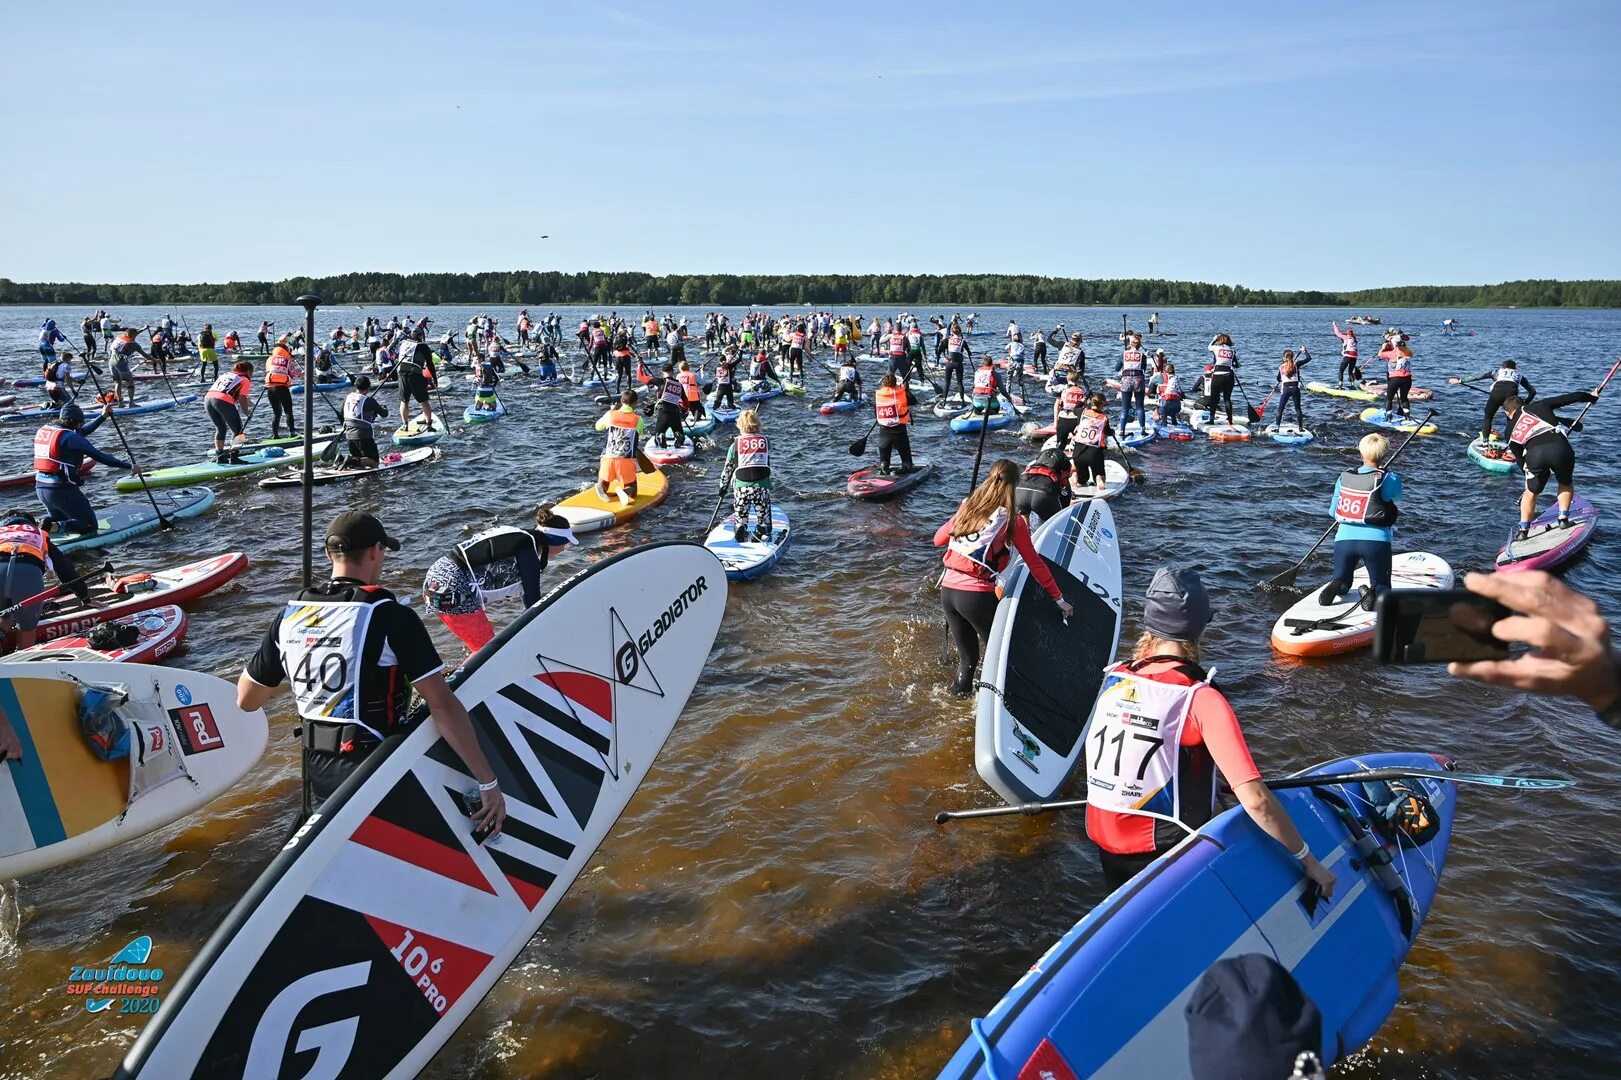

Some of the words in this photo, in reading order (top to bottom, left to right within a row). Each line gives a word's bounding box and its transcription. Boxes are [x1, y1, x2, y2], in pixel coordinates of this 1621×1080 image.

[879, 407, 894, 417] 418
[1512, 416, 1535, 438] 350
[743, 439, 766, 450] 366
[281, 650, 348, 694] 140
[189, 711, 221, 745] red
[1093, 724, 1165, 781] 117
[416, 973, 447, 1013] PRO
